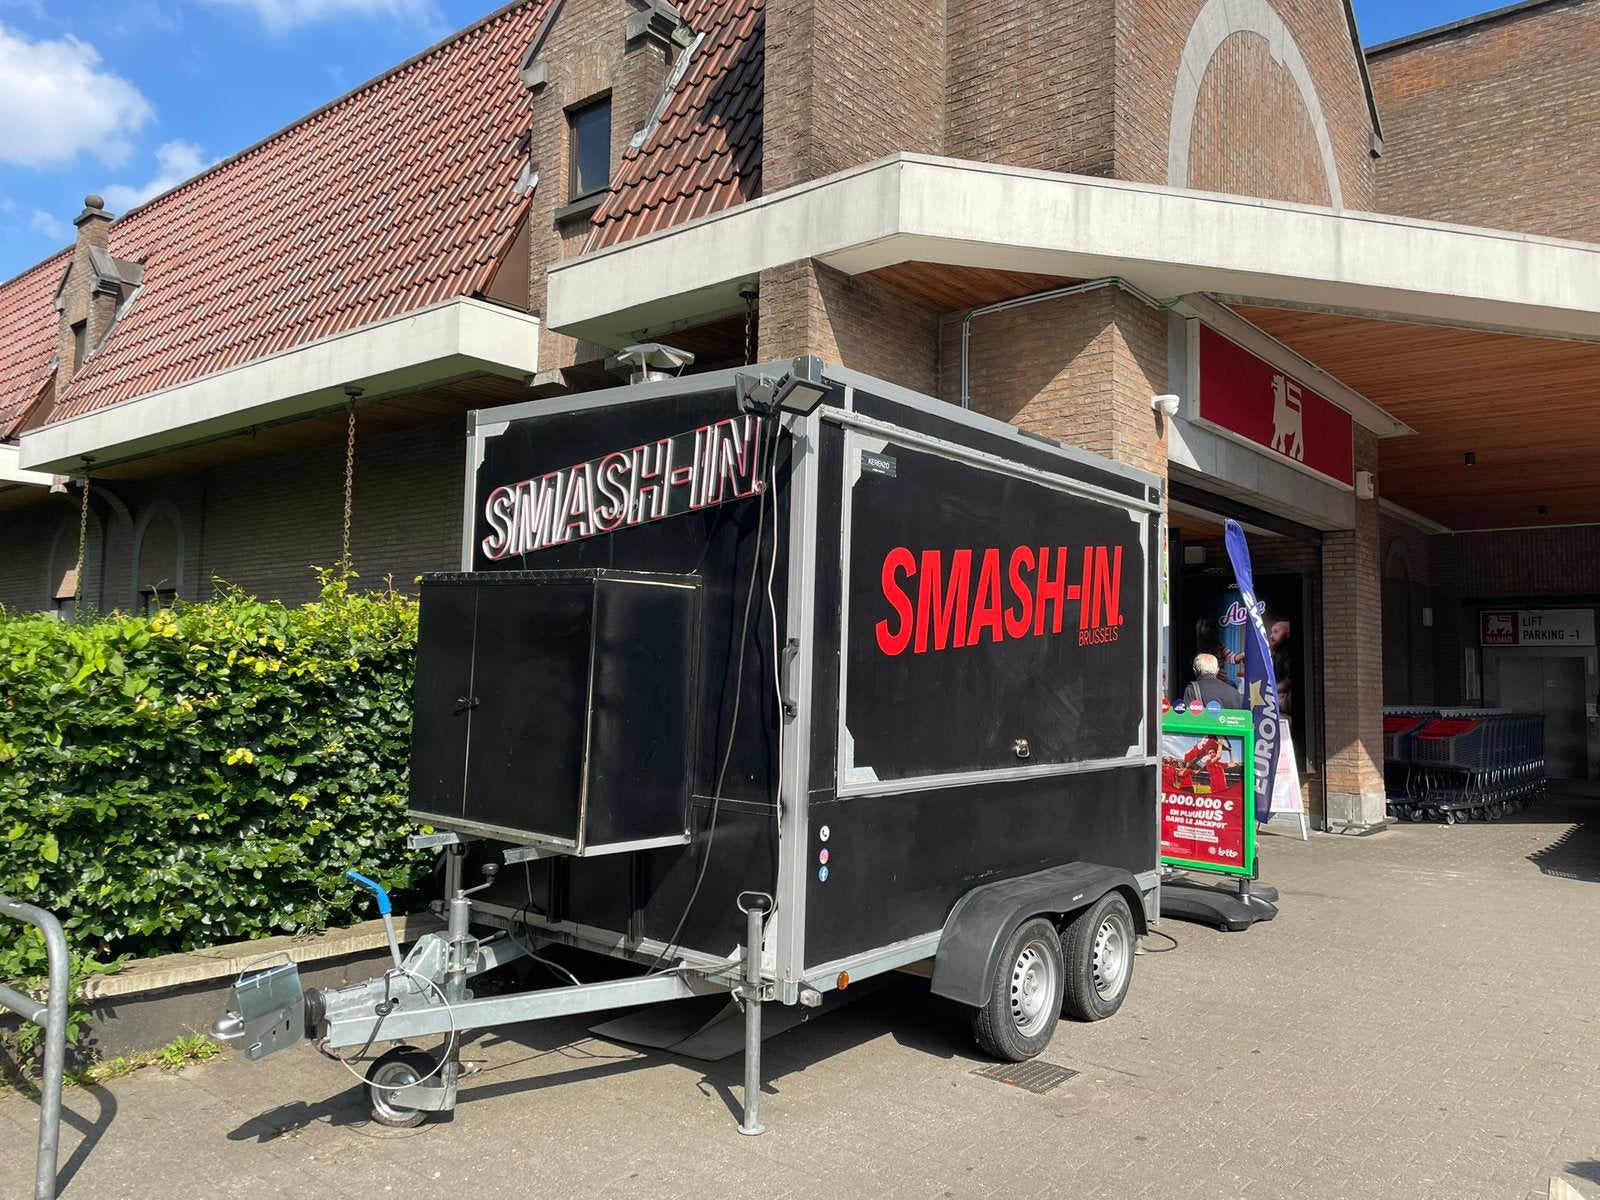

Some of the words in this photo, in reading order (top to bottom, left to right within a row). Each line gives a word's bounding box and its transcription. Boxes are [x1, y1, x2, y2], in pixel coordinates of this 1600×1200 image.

[1219, 601, 1265, 626] Aoe
[1522, 616, 1542, 627] LIFT
[1078, 626, 1119, 646] BRUSSELS
[1523, 629, 1564, 640] PARKING
[1165, 815, 1185, 824] DANS
